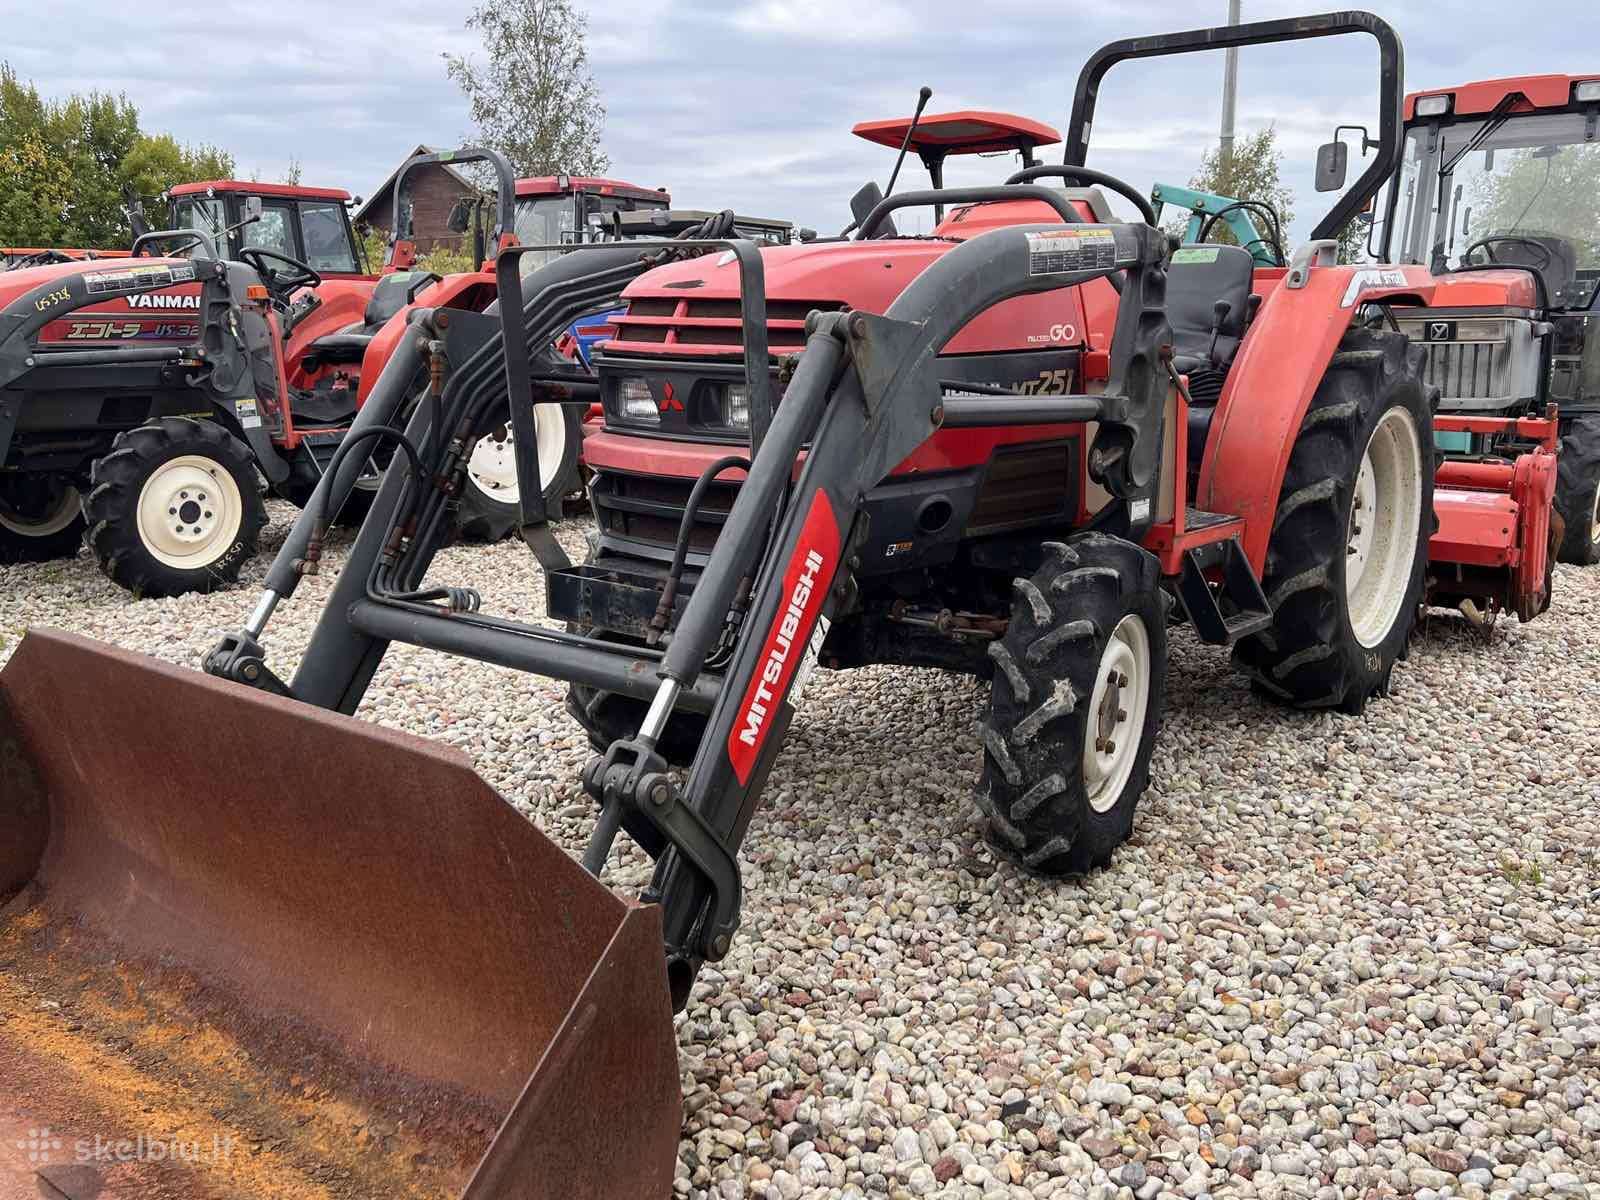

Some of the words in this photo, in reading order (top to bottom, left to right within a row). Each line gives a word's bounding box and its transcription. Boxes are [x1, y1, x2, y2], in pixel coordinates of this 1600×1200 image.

[67, 322, 141, 339] エコトラ
[1050, 324, 1075, 341] GO
[739, 549, 824, 747] MITSUBISHI
